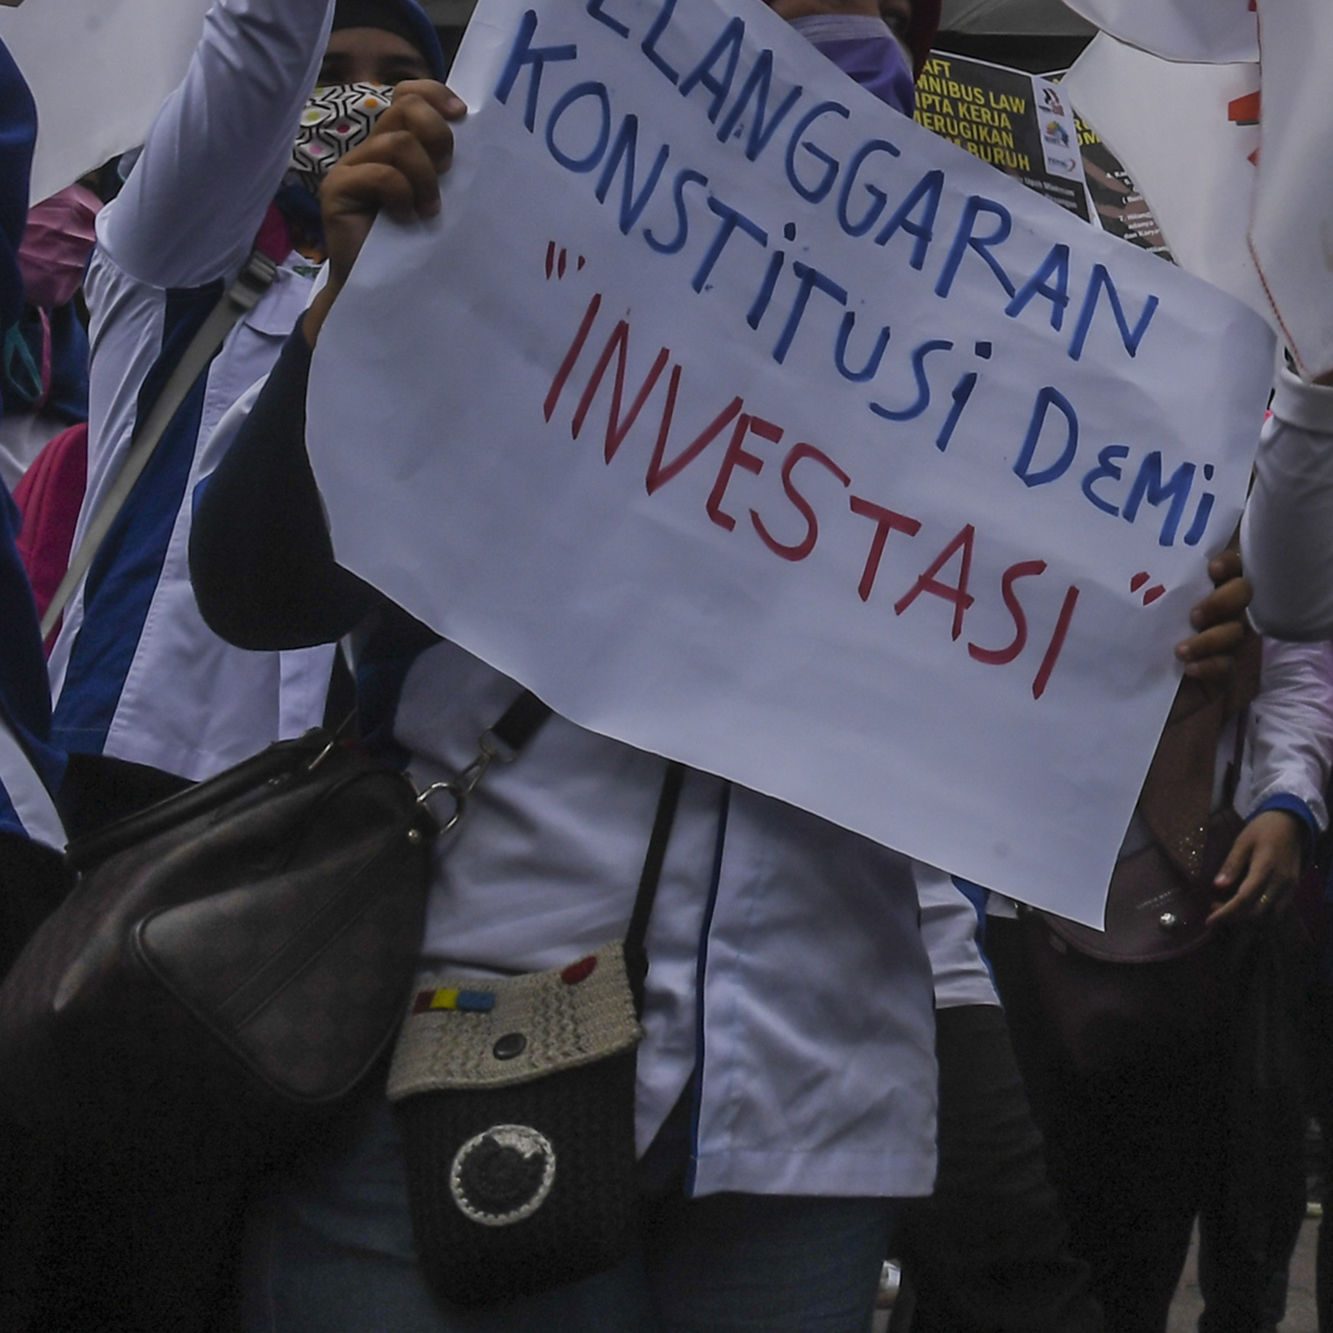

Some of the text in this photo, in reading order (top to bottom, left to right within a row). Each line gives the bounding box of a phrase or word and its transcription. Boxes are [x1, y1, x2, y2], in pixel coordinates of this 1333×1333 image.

[914, 90, 1012, 131] IPTA KERJA
[916, 75, 1026, 115] MNIBUS LAW
[967, 142, 1031, 172] BURUH
